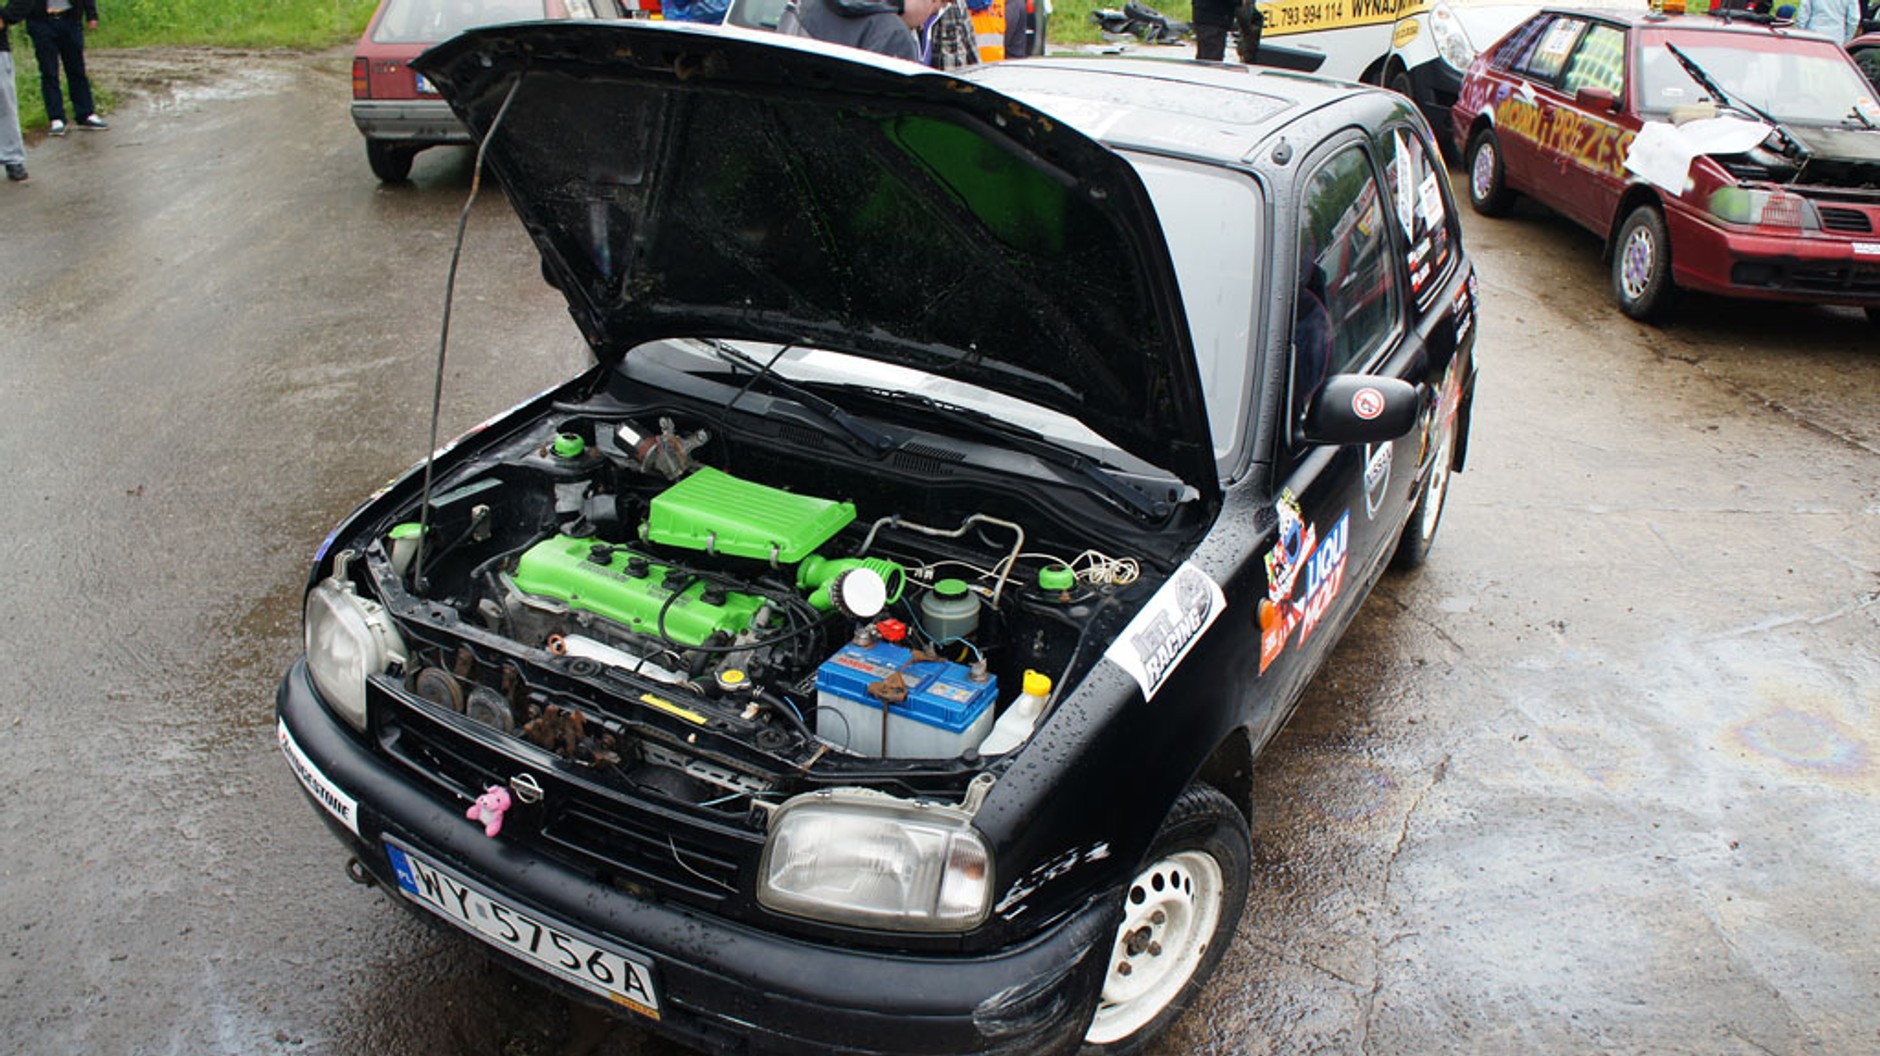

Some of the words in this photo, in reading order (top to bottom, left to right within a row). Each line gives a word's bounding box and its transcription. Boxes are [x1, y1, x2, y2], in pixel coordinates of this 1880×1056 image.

[1262, 10, 1278, 29] EL.
[1281, 7, 1299, 26] 793
[1303, 5, 1322, 24] 994
[1326, 3, 1342, 21] 114
[1352, 0, 1424, 18] WYNAJ
[1550, 106, 1637, 178] PREZES
[1308, 514, 1348, 597] LIQUI
[1299, 559, 1346, 645] MOLY
[1146, 608, 1202, 688] RACING
[396, 868, 415, 885] PL
[412, 858, 471, 920] WY
[490, 904, 652, 1004] 5756A
